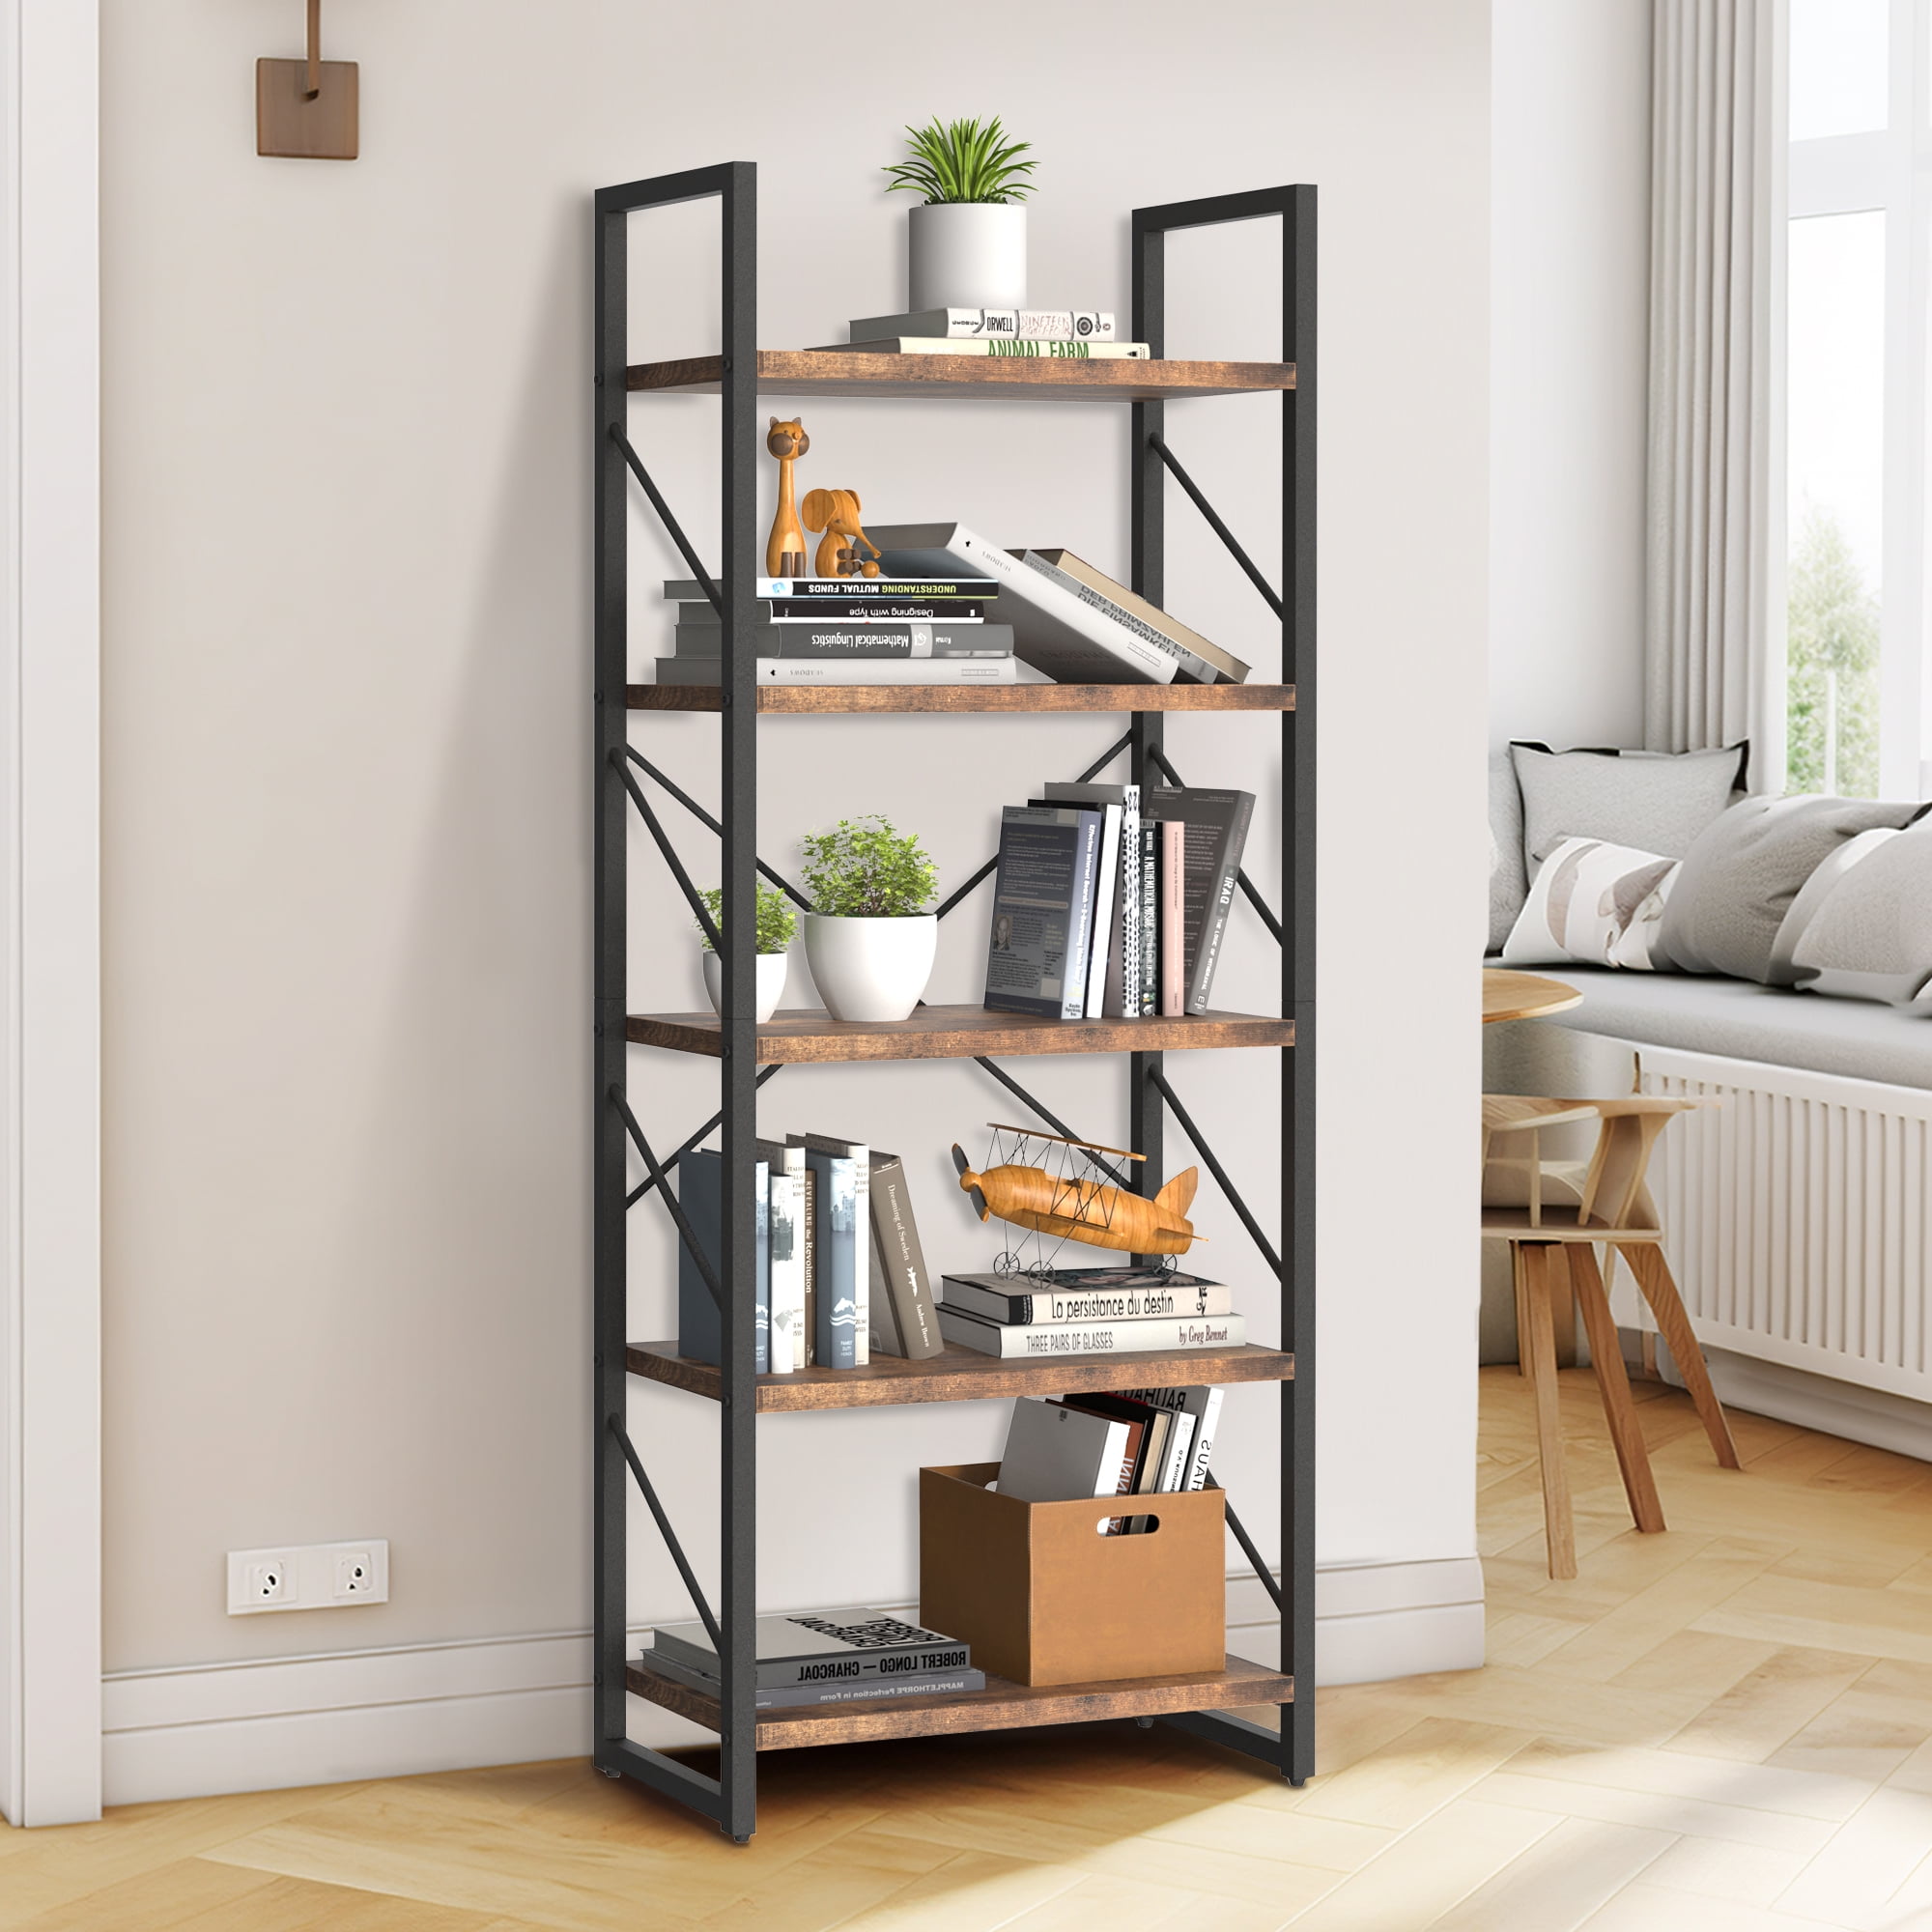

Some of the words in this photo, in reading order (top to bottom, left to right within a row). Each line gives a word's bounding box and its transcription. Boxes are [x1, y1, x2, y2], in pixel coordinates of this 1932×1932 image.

[986, 317, 1013, 331] ORWELL
[1050, 341, 1089, 358] FARM
[809, 584, 839, 593] FUNDS
[840, 584, 879, 593] MUTUAL
[882, 584, 956, 594] UNDERSTANDING
[849, 608, 869, 617] Type
[891, 608, 934, 617] Designing
[811, 633, 854, 647] Linguistics
[856, 634, 909, 648] Mathematical
[1144, 862, 1155, 905] MATHEMATICAL
[1219, 875, 1234, 905] IRAQ
[888, 1184, 902, 1223] Dreaming
[896, 1221, 903, 1231] of
[898, 1230, 910, 1261] Sweden
[1052, 1293, 1063, 1319] La
[1065, 1293, 1124, 1323] persistance
[1127, 1292, 1141, 1315] du
[1144, 1290, 1174, 1314] destin
[921, 1326, 930, 1348] Brown
[1026, 1335, 1049, 1352] THREE
[1050, 1334, 1070, 1351] PAIRS
[1072, 1333, 1082, 1350] OF
[1083, 1331, 1114, 1350] GLASSES
[1179, 1325, 1187, 1346] by
[1188, 1325, 1205, 1346] Greg
[1206, 1324, 1228, 1343] Bennet
